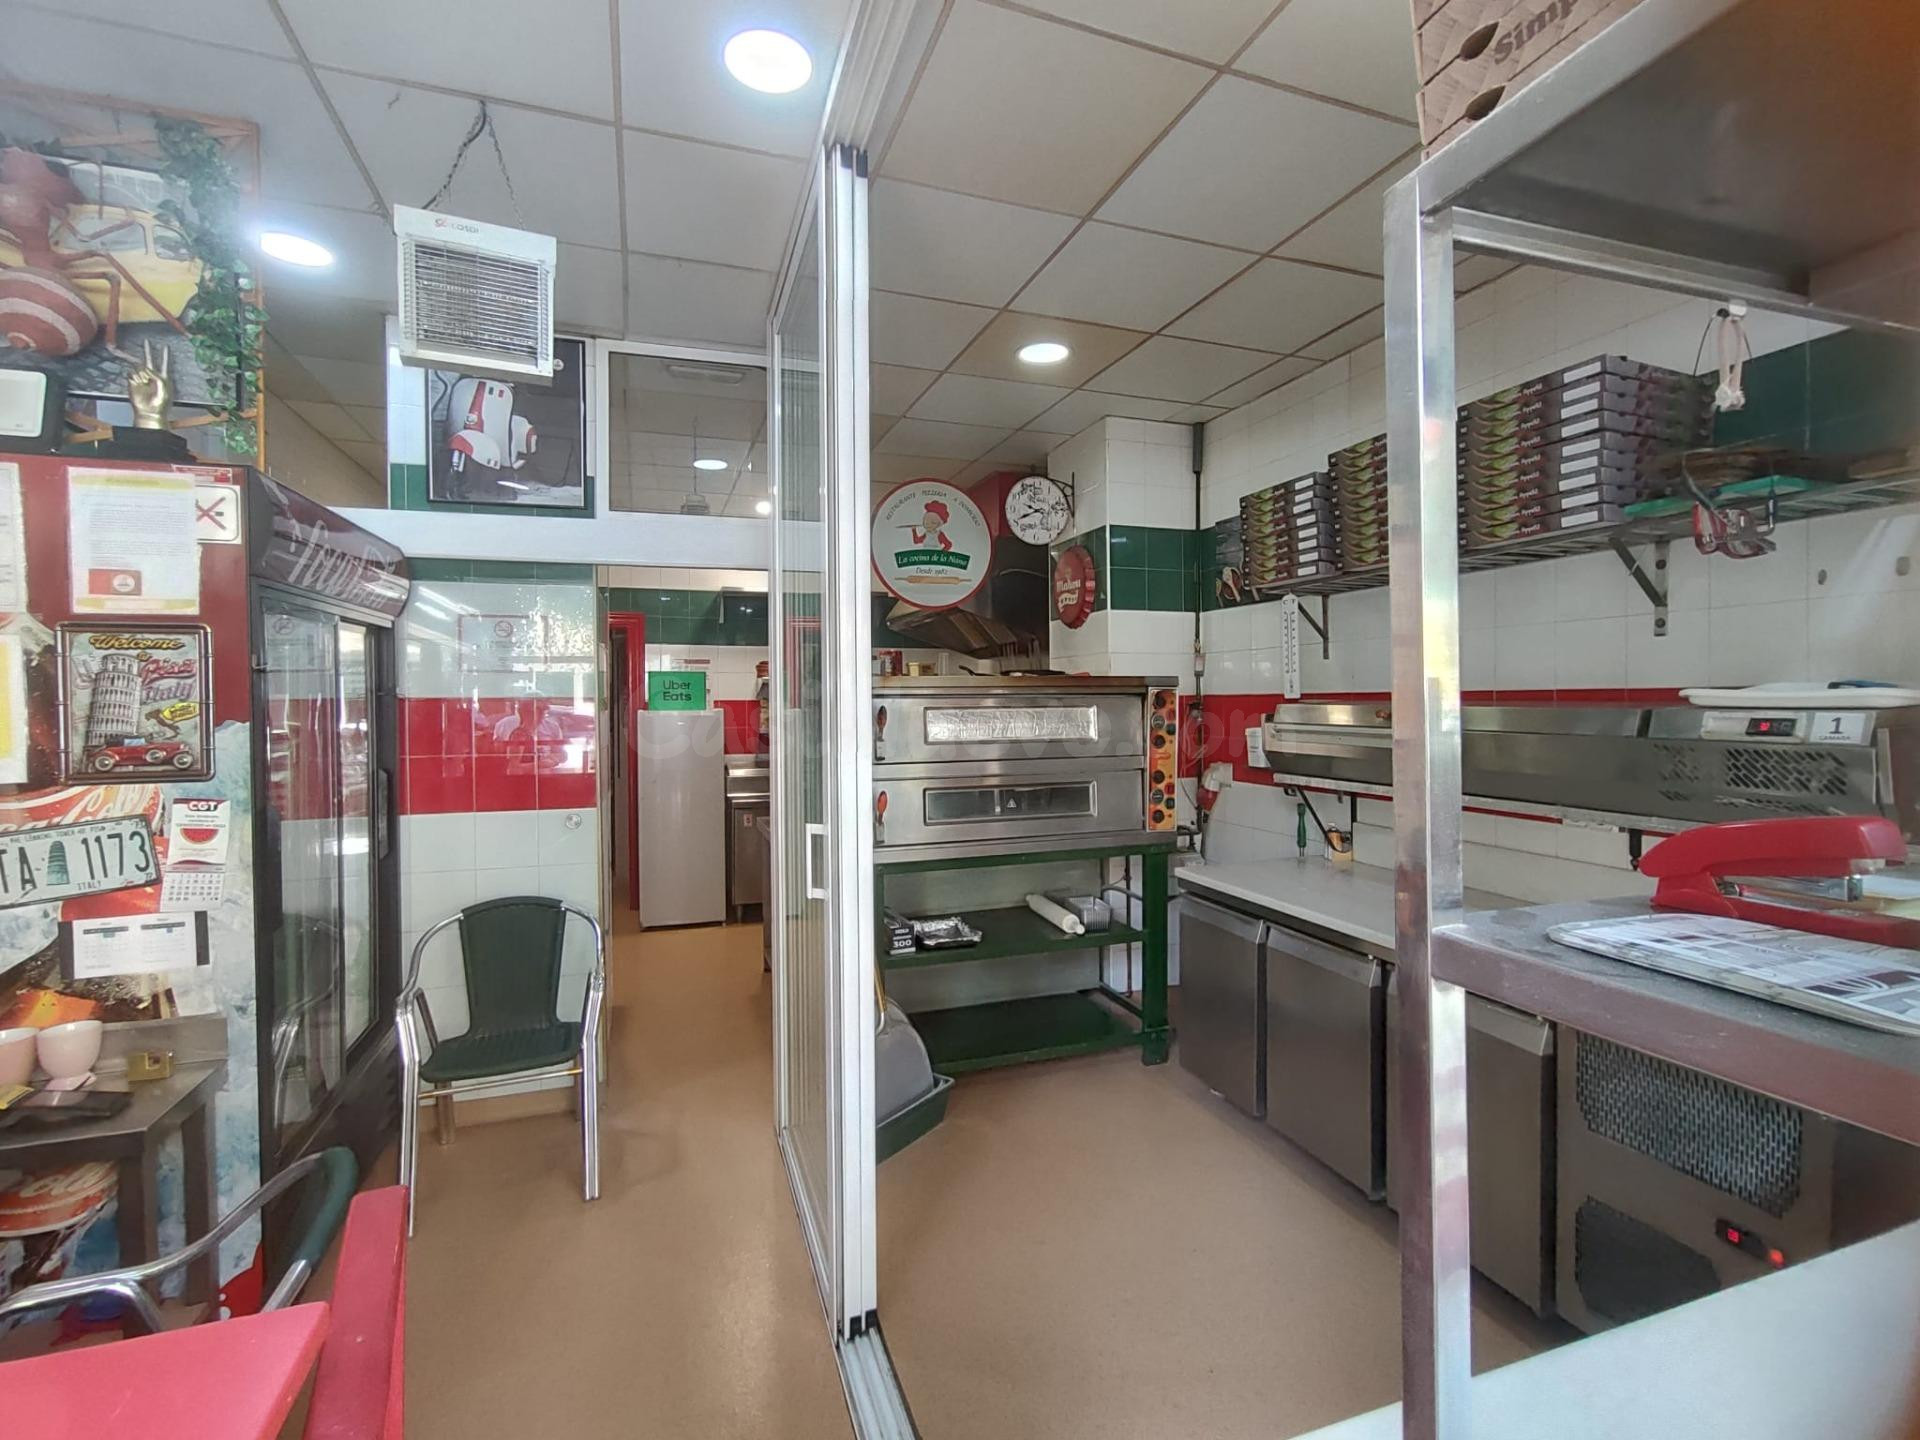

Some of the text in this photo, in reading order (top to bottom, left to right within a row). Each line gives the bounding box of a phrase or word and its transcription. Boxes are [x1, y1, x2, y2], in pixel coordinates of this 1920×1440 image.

[89, 634, 186, 650] Welcome
[140, 658, 197, 685] Pisa
[663, 680, 691, 690] Uber
[663, 692, 692, 702] Eats
[1830, 718, 1843, 734] 1
[188, 800, 218, 811] CGT
[81, 830, 150, 881] 1173
[77, 881, 102, 891] ITALY
